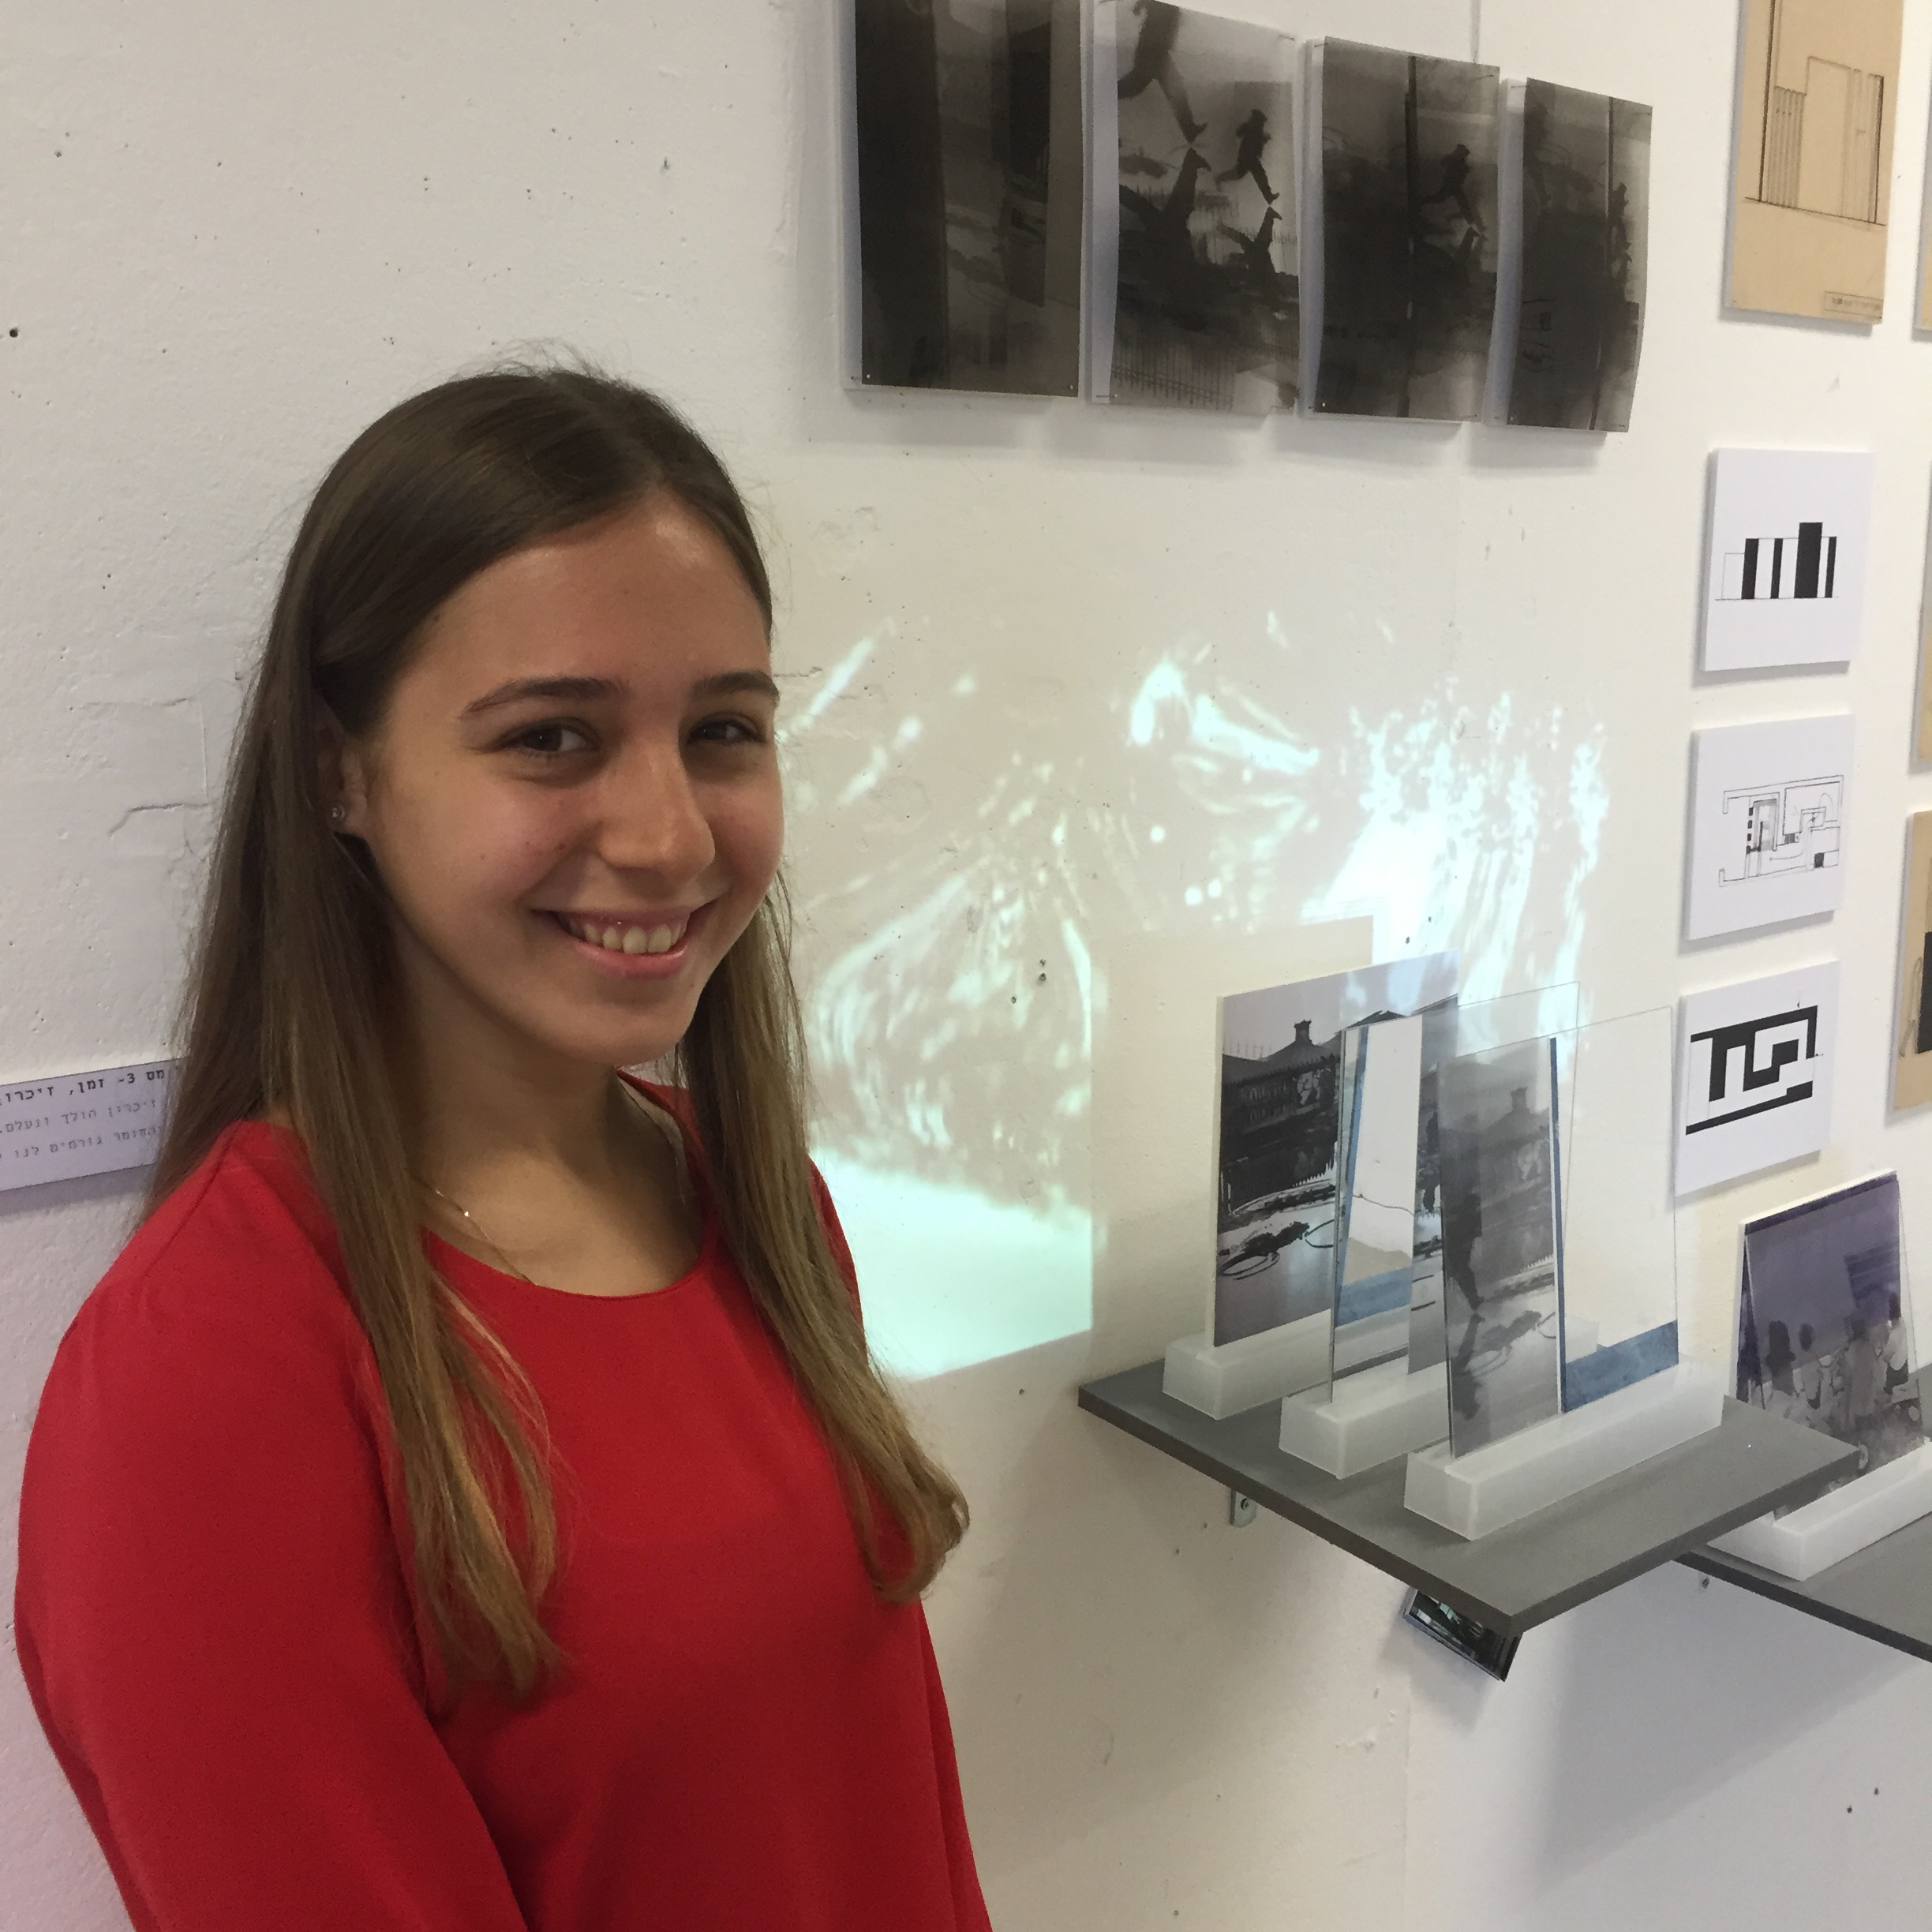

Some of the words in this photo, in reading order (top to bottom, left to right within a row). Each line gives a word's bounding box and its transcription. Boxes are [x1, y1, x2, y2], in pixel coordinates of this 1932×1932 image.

[69, 1078, 104, 1095] זמן,
[0, 1086, 54, 1105] זיכרו
[61, 1109, 97, 1125] הולך
[114, 1126, 161, 1140] החומר
[15, 1145, 39, 1158] לנו
[49, 1136, 103, 1153] גורמים
